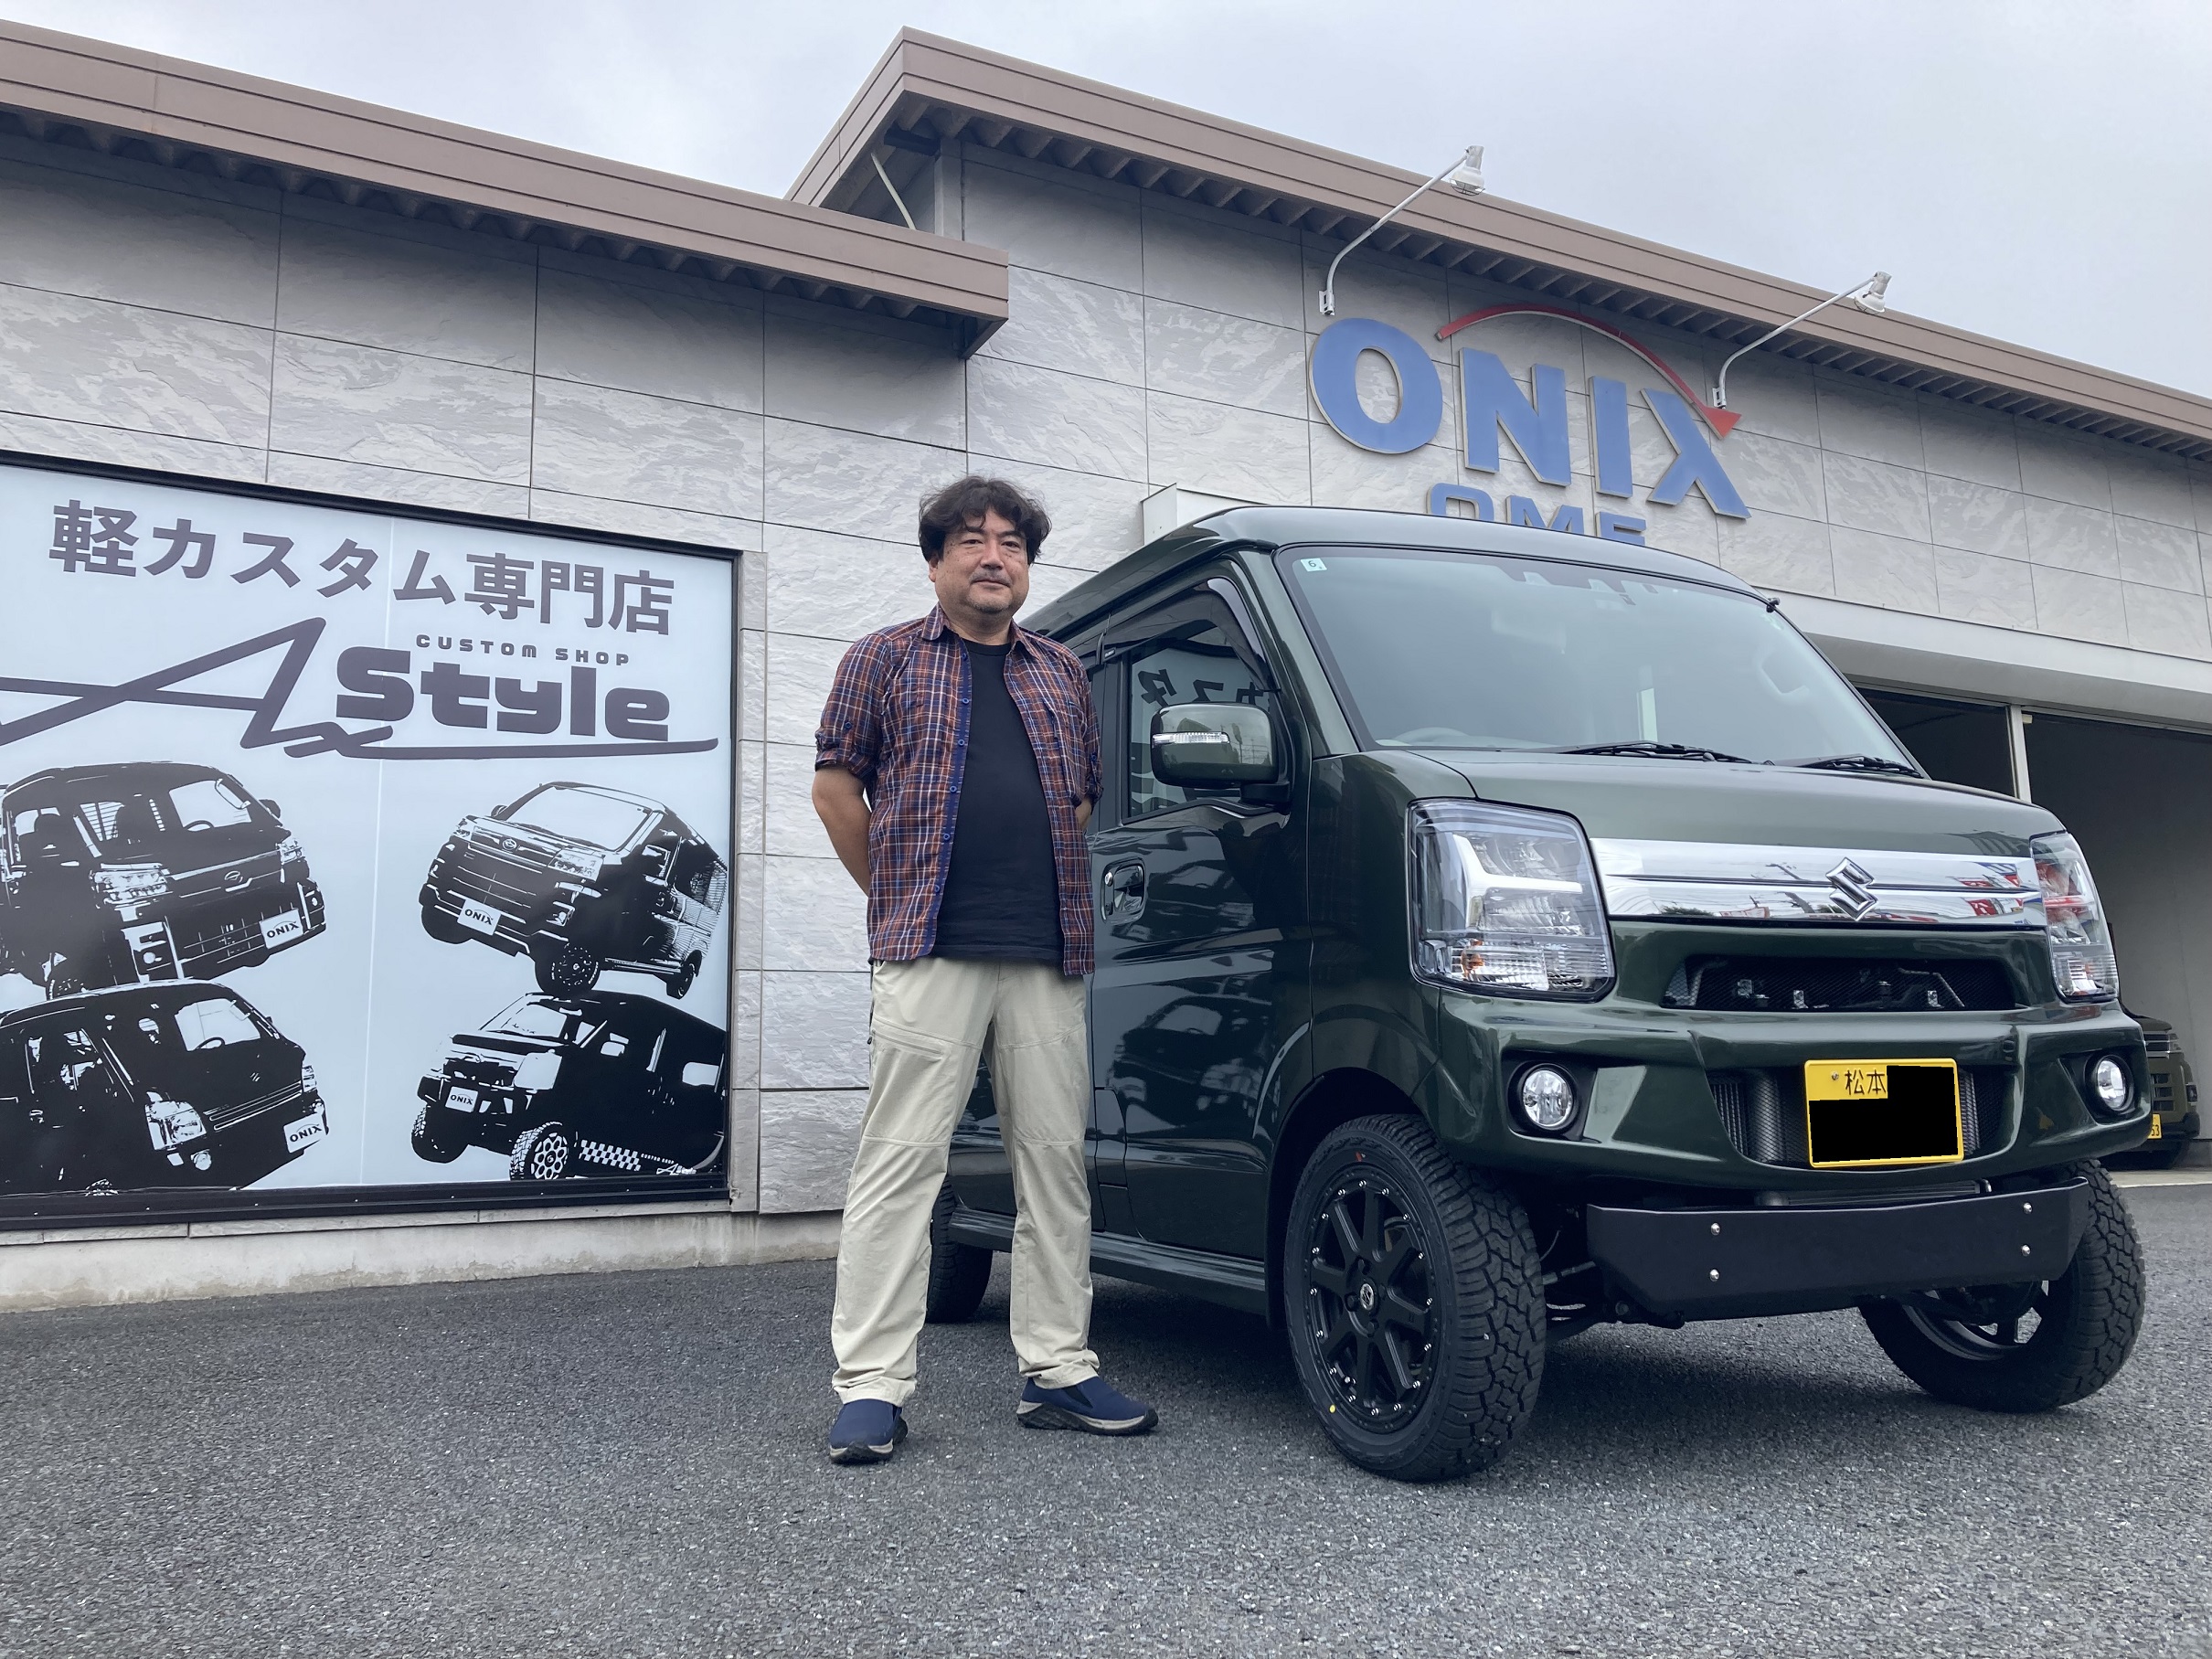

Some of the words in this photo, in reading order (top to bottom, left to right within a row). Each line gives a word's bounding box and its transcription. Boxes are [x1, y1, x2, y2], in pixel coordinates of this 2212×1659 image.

[1309, 317, 1751, 519] ONIX
[48, 500, 675, 635] 軽カスタム専門店
[416, 633, 537, 658] CUSTOM
[555, 647, 630, 665] SHOP
[336, 645, 671, 741] Style
[465, 909, 492, 925] ONIX
[267, 923, 300, 938] ONIX
[1844, 1069, 1887, 1095] 松本
[451, 1094, 473, 1105] ONIX
[290, 1125, 322, 1142] ONIX
